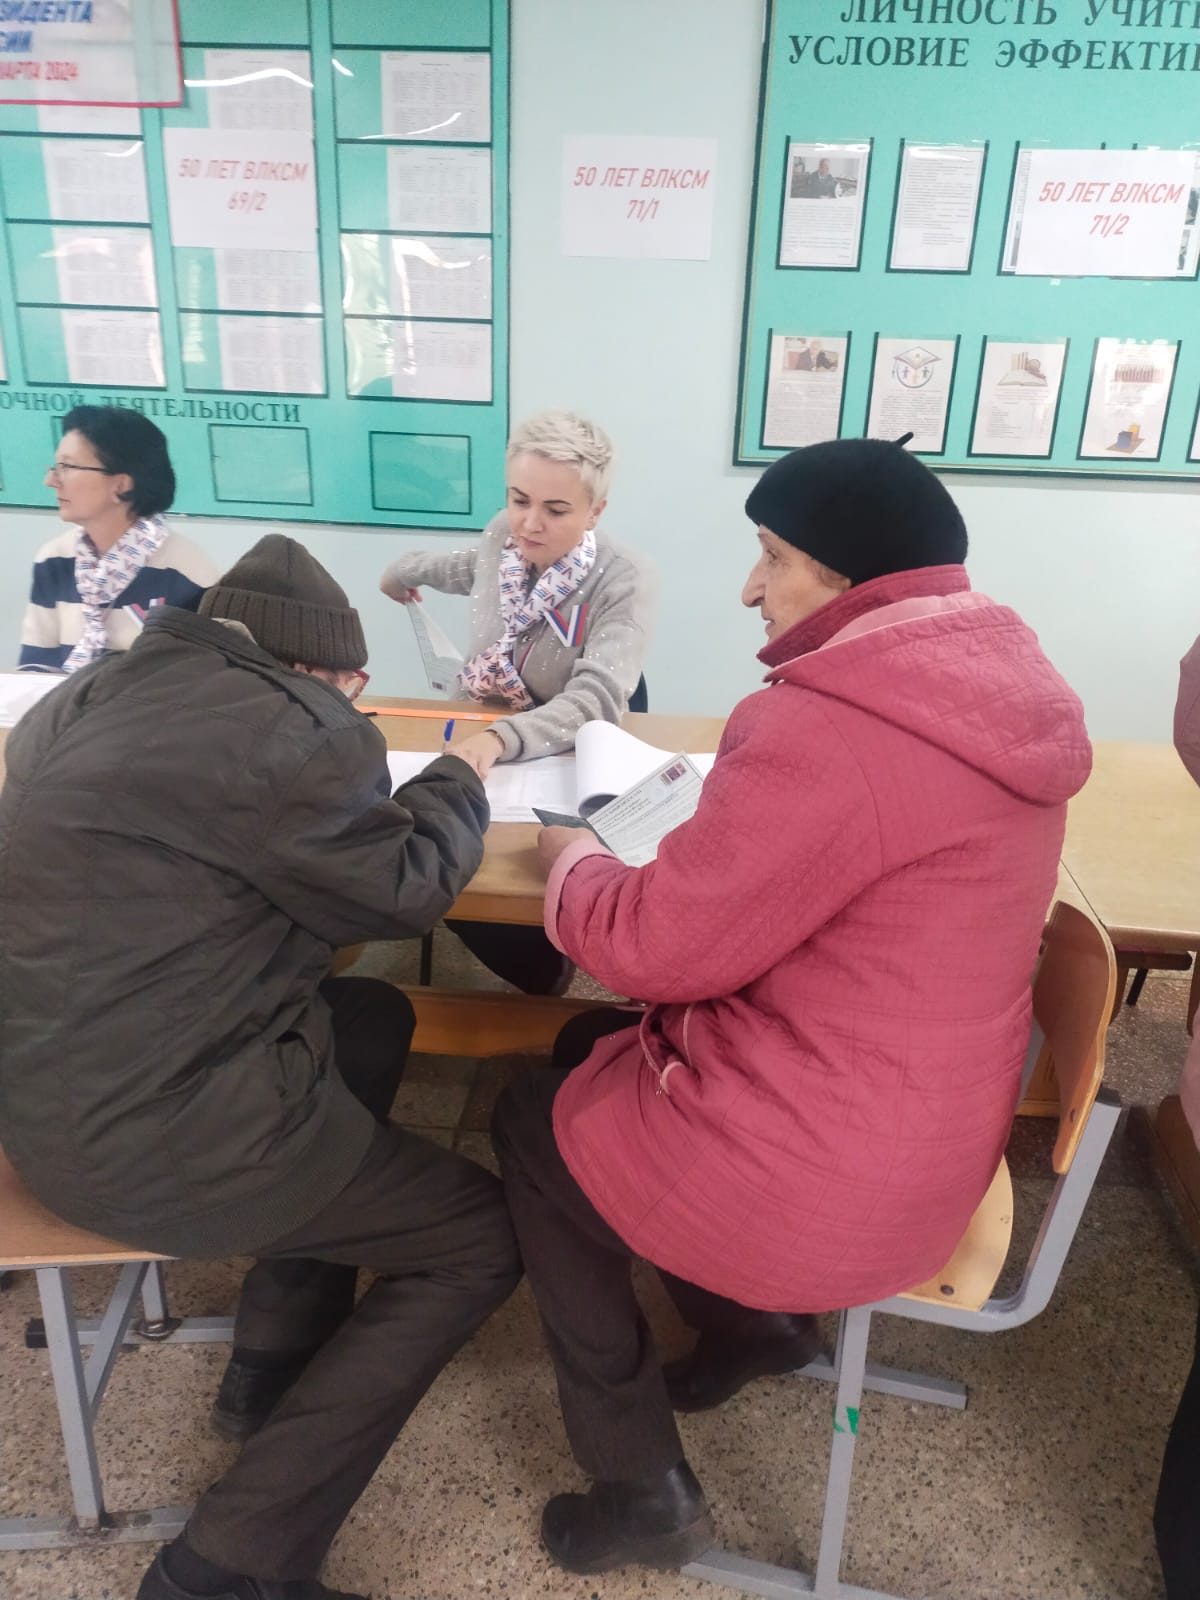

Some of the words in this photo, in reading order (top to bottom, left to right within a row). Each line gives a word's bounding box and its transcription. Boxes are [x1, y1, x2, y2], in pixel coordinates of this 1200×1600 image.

[840, 0, 1057, 25] ЛИЧНОСТЬ
[788, 35, 970, 67] УСЛОВИЕ
[179, 158, 200, 178] 50
[205, 159, 240, 179] ЛЕТ
[243, 161, 308, 182] ВЛКСМ
[573, 166, 597, 187] 50
[600, 167, 640, 188] ЛЕТ
[640, 168, 710, 189] ВЛКСМ
[227, 191, 268, 215] 69/2
[1039, 181, 1066, 202] 50
[1067, 182, 1110, 203] ЛЕТ
[1109, 182, 1185, 204] ВЛКСМ
[626, 197, 661, 223] 71/1
[1089, 213, 1131, 239] 71/2
